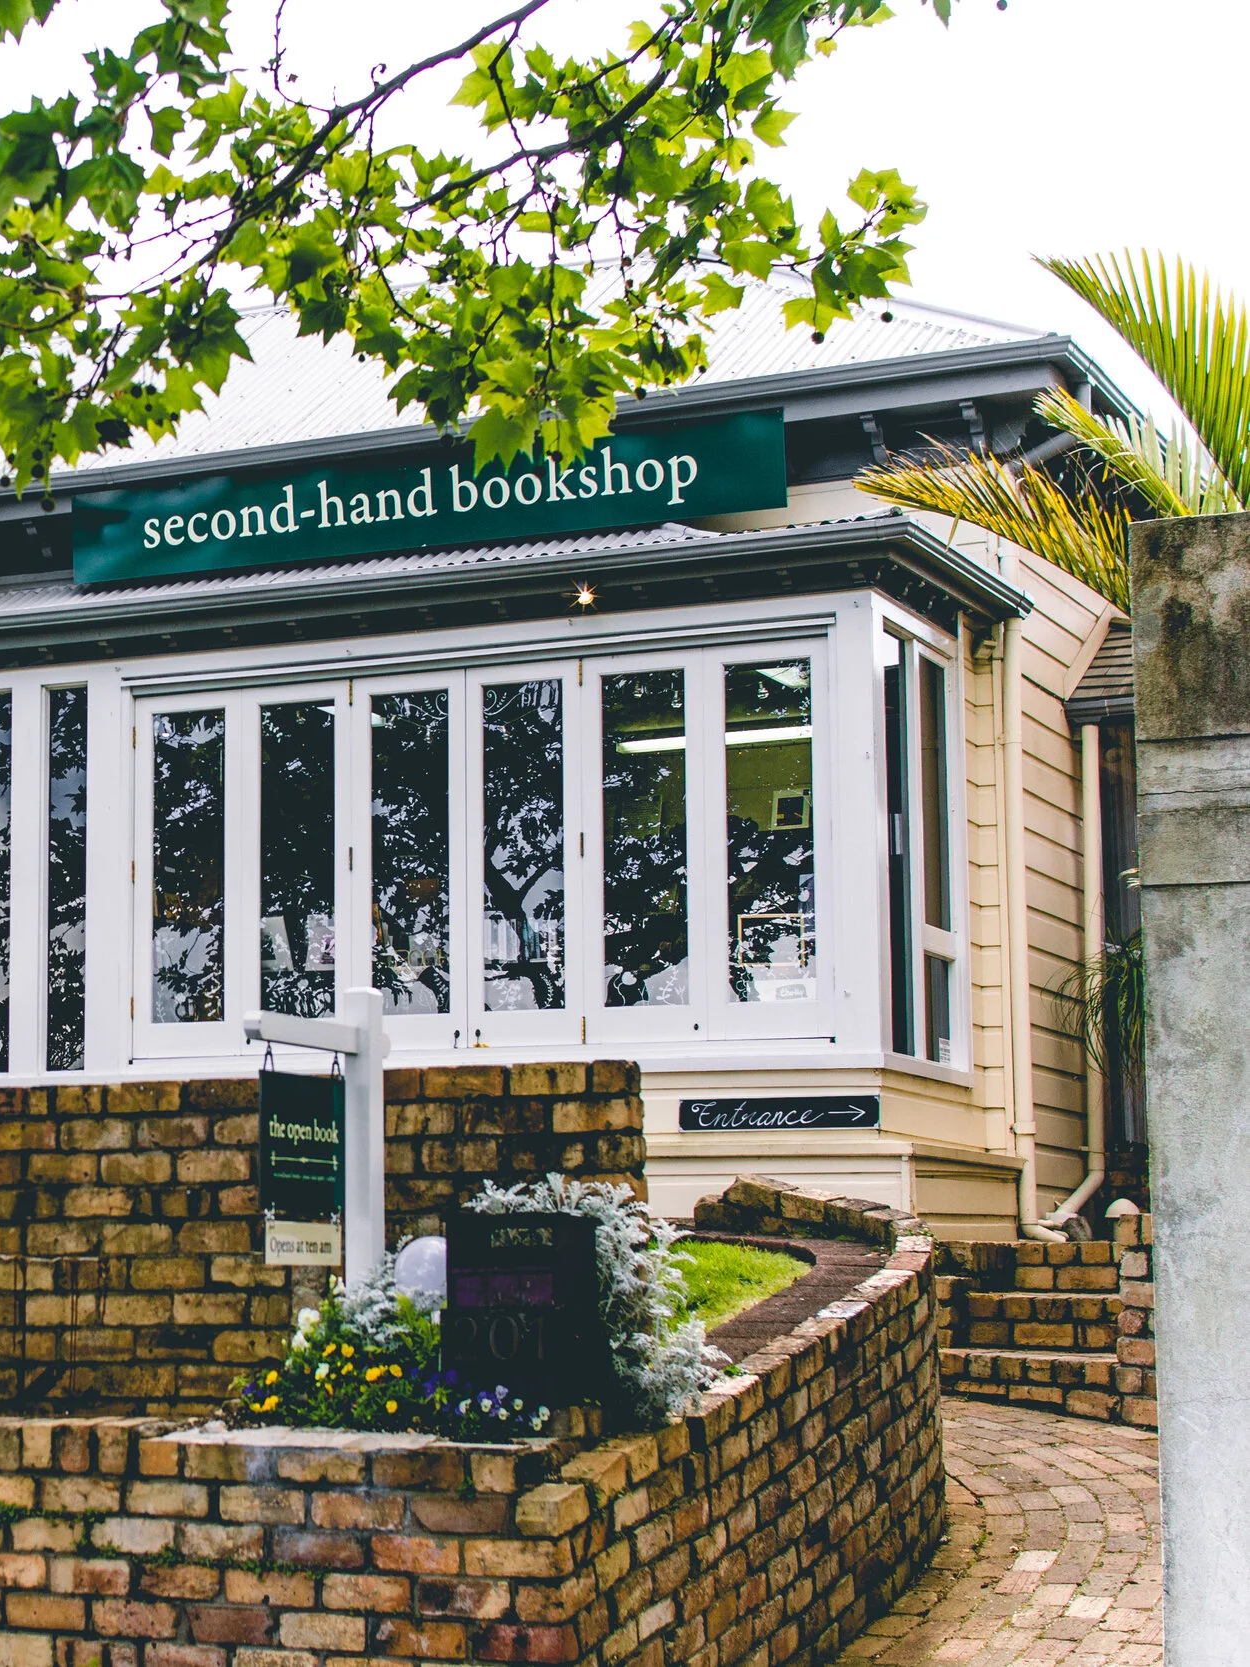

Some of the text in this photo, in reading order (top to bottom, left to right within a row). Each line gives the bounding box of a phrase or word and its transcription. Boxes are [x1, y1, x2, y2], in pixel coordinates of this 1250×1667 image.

[142, 445, 699, 549] second-hand bookshop
[691, 1101, 824, 1128] Entrance
[269, 1114, 339, 1146] the open book
[270, 1236, 332, 1257] Opens at ten am
